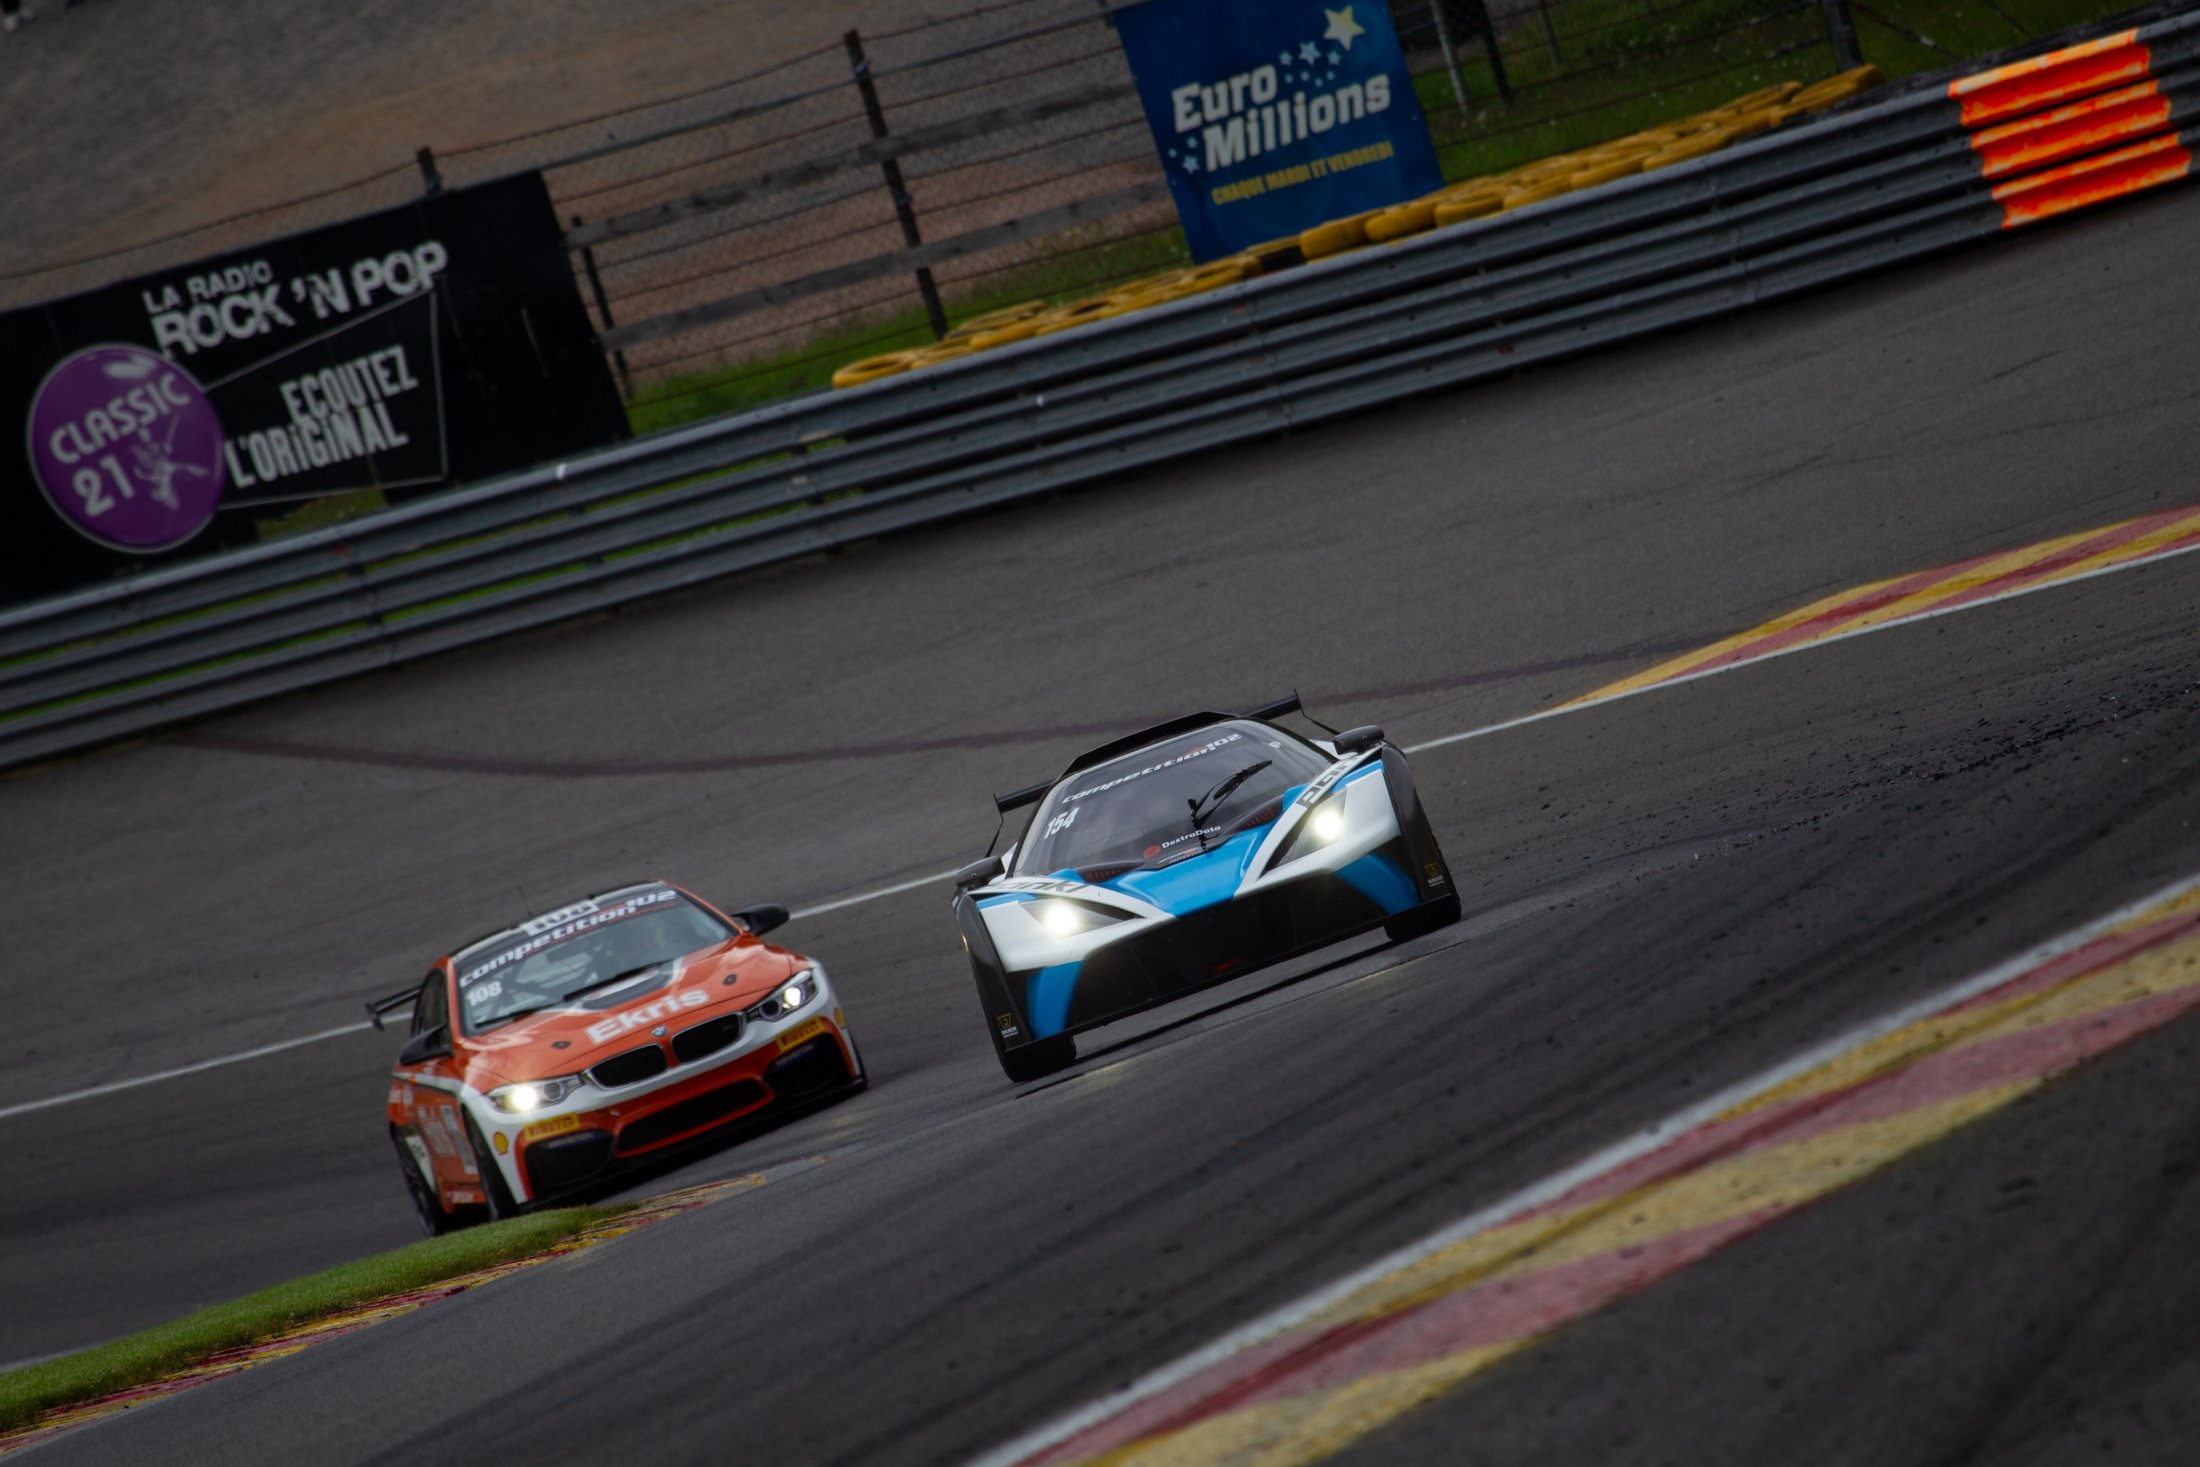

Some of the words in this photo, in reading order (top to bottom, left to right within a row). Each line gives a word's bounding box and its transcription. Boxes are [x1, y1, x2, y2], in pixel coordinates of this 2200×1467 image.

[1171, 63, 1278, 134] Euro
[1201, 73, 1392, 173] Millions
[1210, 175, 1267, 206] CHAQUE
[1310, 157, 1329, 179] ET
[1327, 140, 1396, 175] VENDREDI
[141, 281, 181, 316] LA
[185, 261, 275, 302] RADIO
[148, 282, 297, 361] ROCK
[291, 268, 352, 321] 'N
[348, 240, 449, 308] POP
[278, 343, 420, 424] ECOUTEZ
[48, 371, 192, 466] CLASSIC
[70, 452, 137, 520] 21
[1043, 806, 1081, 840] 154
[1161, 825, 1222, 850] DextraData
[465, 980, 503, 1007] 108
[586, 988, 709, 1045] Ekris
